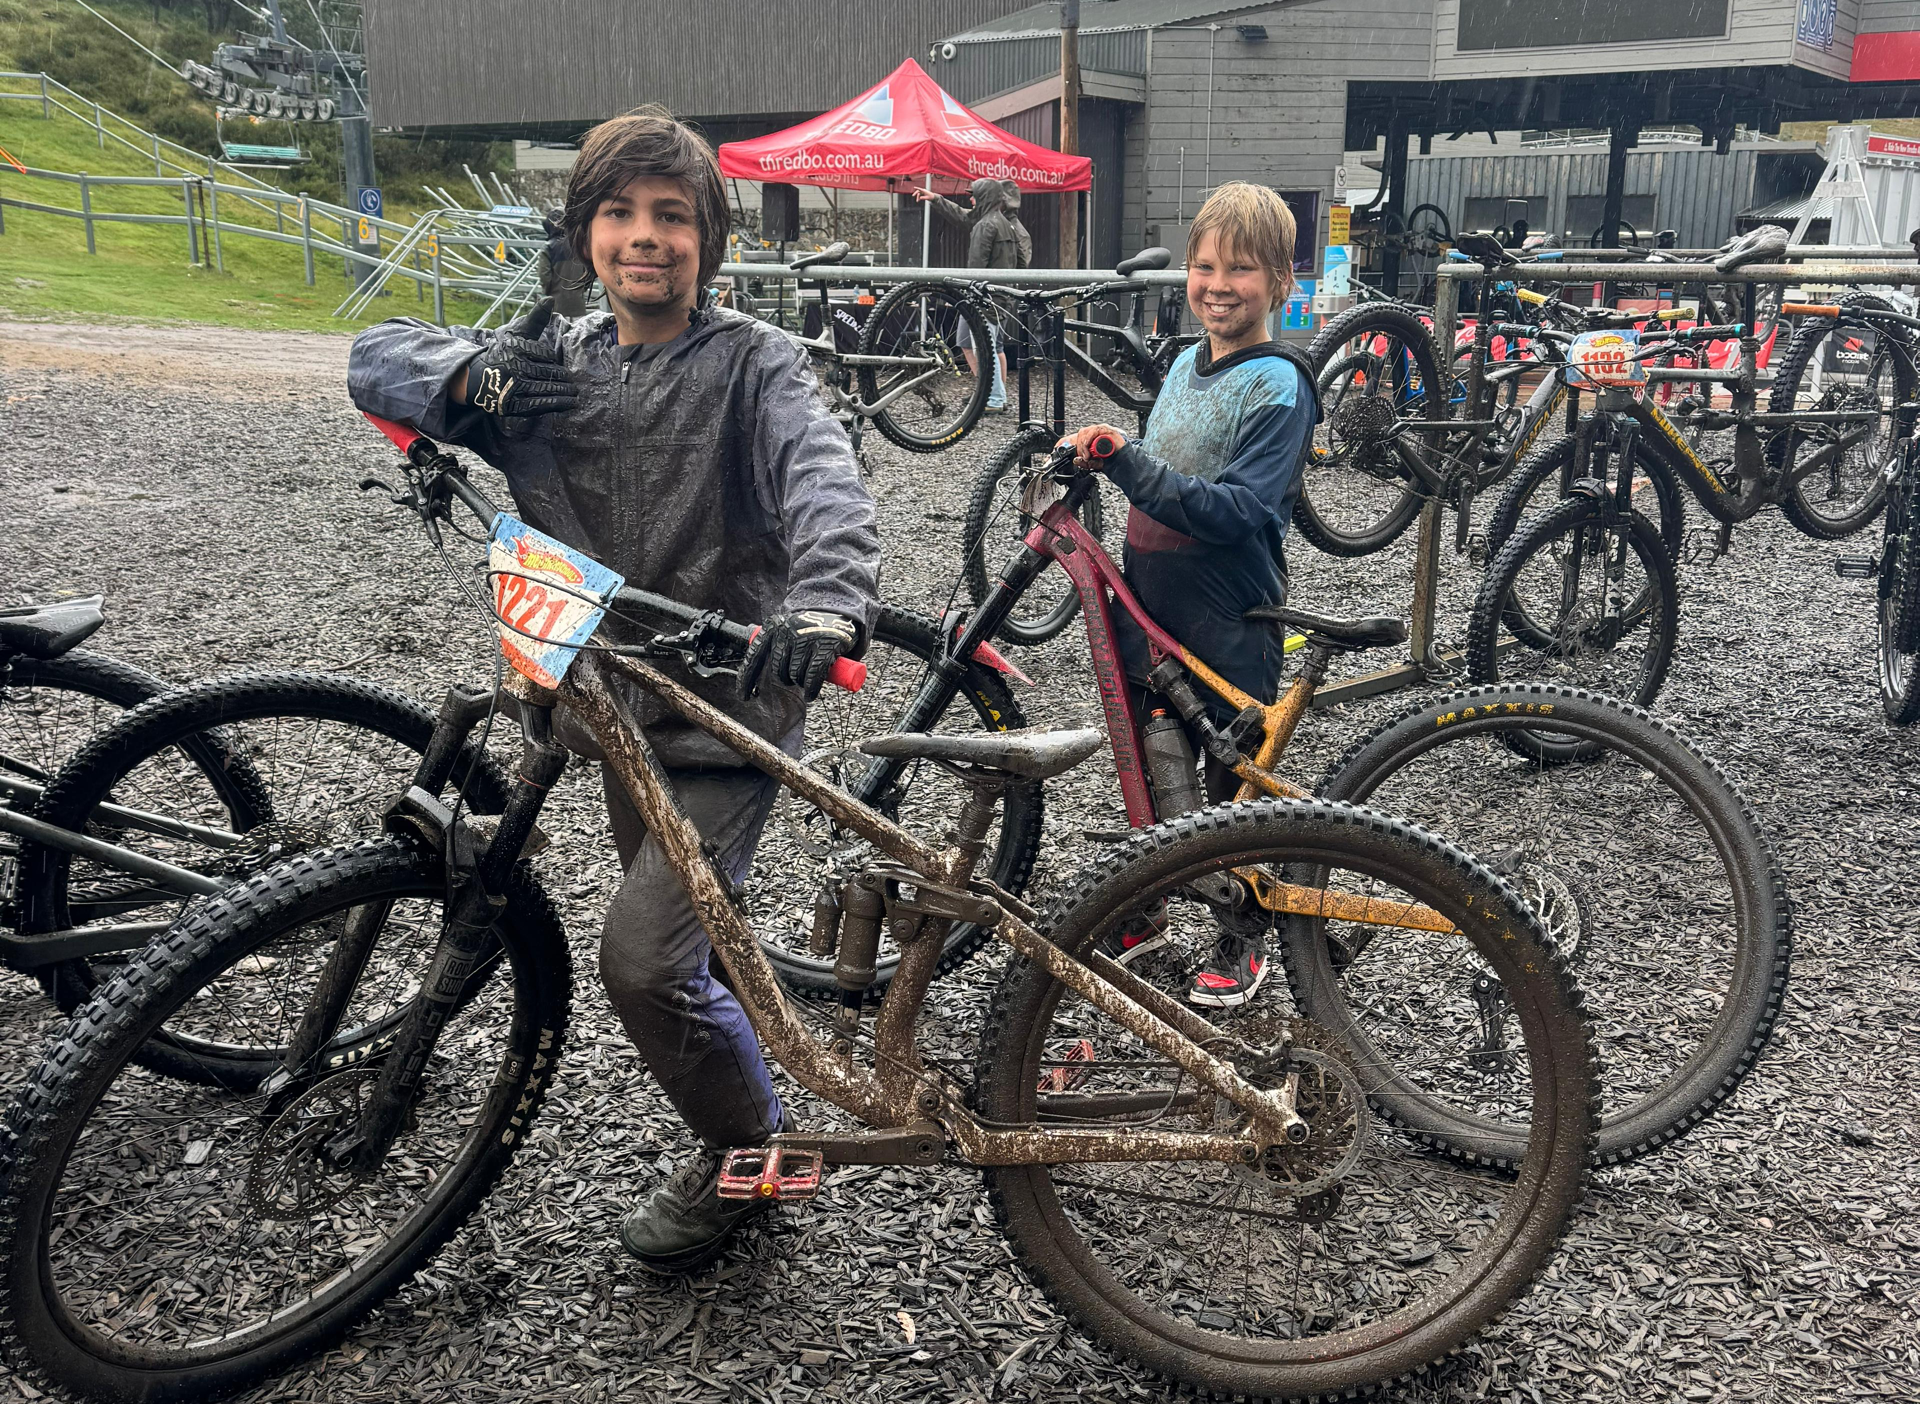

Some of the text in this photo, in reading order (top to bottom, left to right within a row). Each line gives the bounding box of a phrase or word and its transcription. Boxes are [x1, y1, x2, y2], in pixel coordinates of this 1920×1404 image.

[759, 150, 884, 171] thredbo.com.au
[967, 154, 1066, 185] thredbo.com.au
[358, 217, 369, 239] 6
[428, 235, 439, 257] 5
[494, 241, 506, 263] 4
[1836, 350, 1869, 360] boost
[1604, 577, 1623, 618] FOX
[1099, 659, 1134, 773] MOUNTAIN
[1436, 702, 1554, 727] MAXXIS
[399, 1010, 439, 1087] PSYLO
[502, 1027, 554, 1147] MAXXIS
